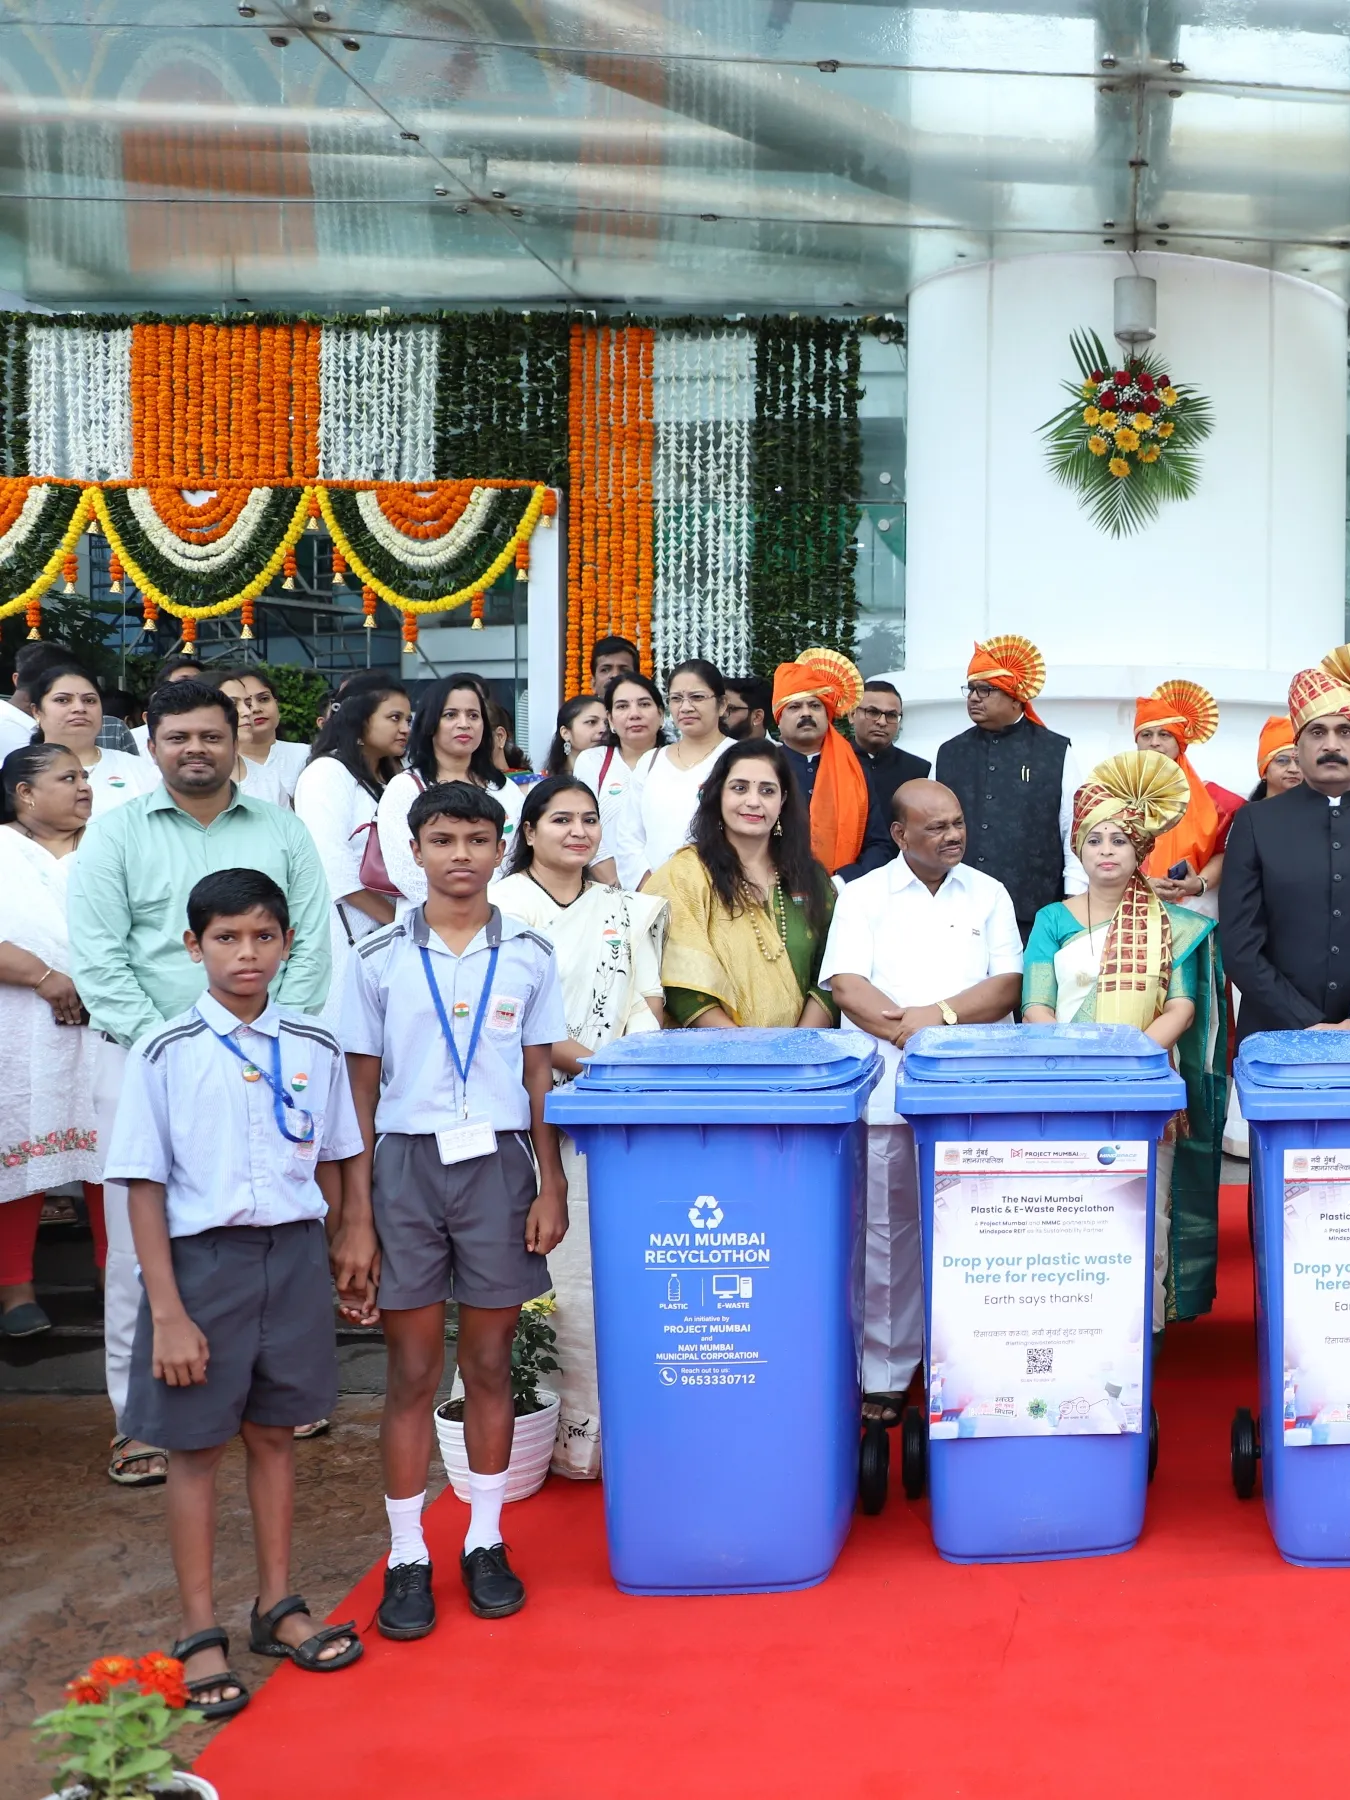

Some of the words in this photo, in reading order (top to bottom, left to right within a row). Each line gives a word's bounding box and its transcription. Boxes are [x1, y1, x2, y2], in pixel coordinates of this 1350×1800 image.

[976, 1148, 988, 1158] मुंबई
[1324, 1155, 1335, 1165] मुंबई
[1021, 1195, 1042, 1203] Navi
[971, 1205, 1003, 1214] Plastic
[1014, 1205, 1054, 1213] E-Waste
[1057, 1205, 1114, 1214] Recyclothon
[650, 1233, 690, 1246] NAVI
[695, 1233, 765, 1246] MUMBAI
[645, 1249, 770, 1263] RECYCLOTHON
[943, 1255, 981, 1270] Drop
[985, 1256, 1022, 1270] your
[1026, 1253, 1080, 1269] plastic
[1085, 1254, 1132, 1264] waste
[1293, 1262, 1331, 1277] Drop
[965, 1272, 1001, 1283] here
[1005, 1271, 1027, 1282] for
[1031, 1269, 1110, 1285] recycling.
[1315, 1278, 1350, 1290] here
[984, 1295, 1015, 1304] Earth
[1019, 1295, 1046, 1306] says
[1050, 1293, 1093, 1303] thanks!
[664, 1325, 706, 1333] PROJECT
[710, 1324, 750, 1333] MUMBAI
[681, 1374, 755, 1385] 9653330712
